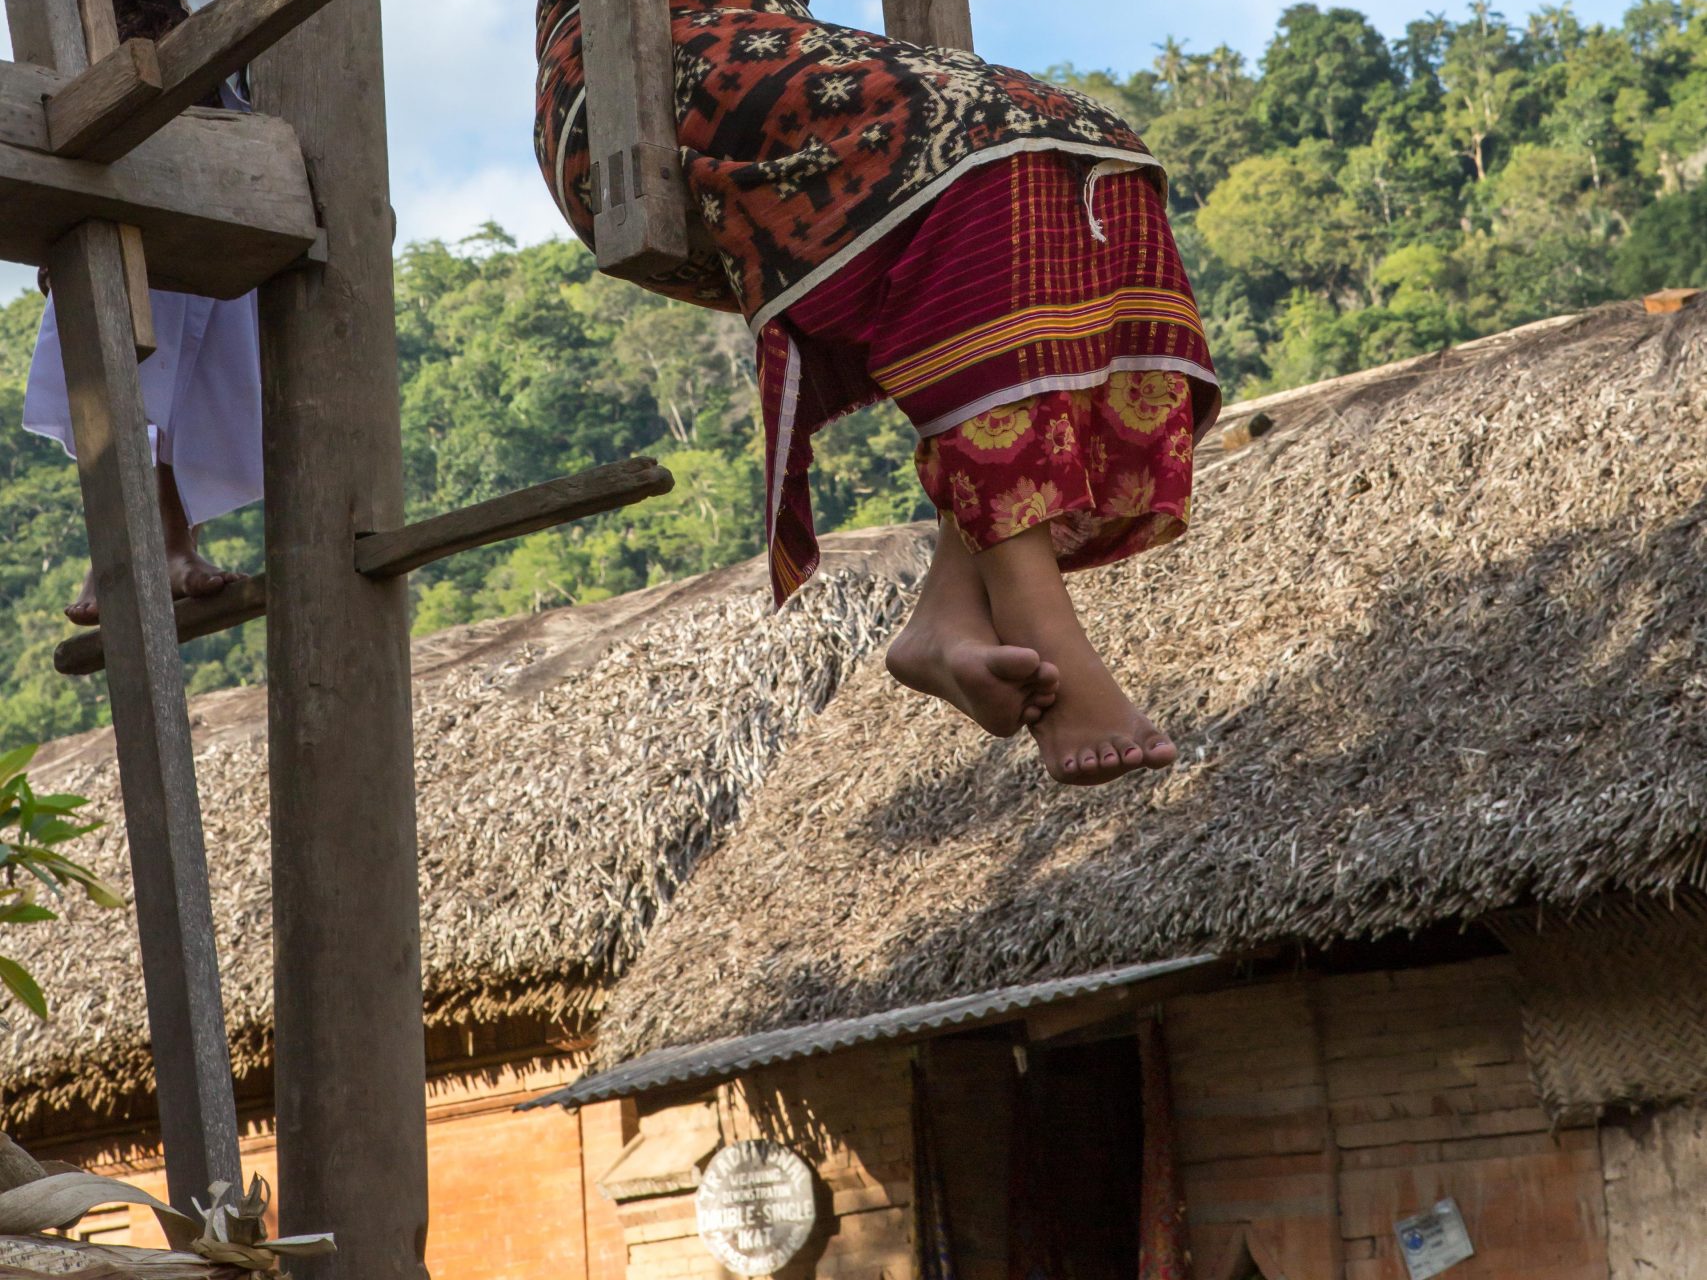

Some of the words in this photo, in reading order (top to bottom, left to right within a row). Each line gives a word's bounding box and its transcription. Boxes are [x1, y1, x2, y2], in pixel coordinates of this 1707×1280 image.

[729, 1168, 781, 1186] WEAVING
[722, 1184, 791, 1203] DEMONSTRATION
[738, 1227, 773, 1250] IKAT
